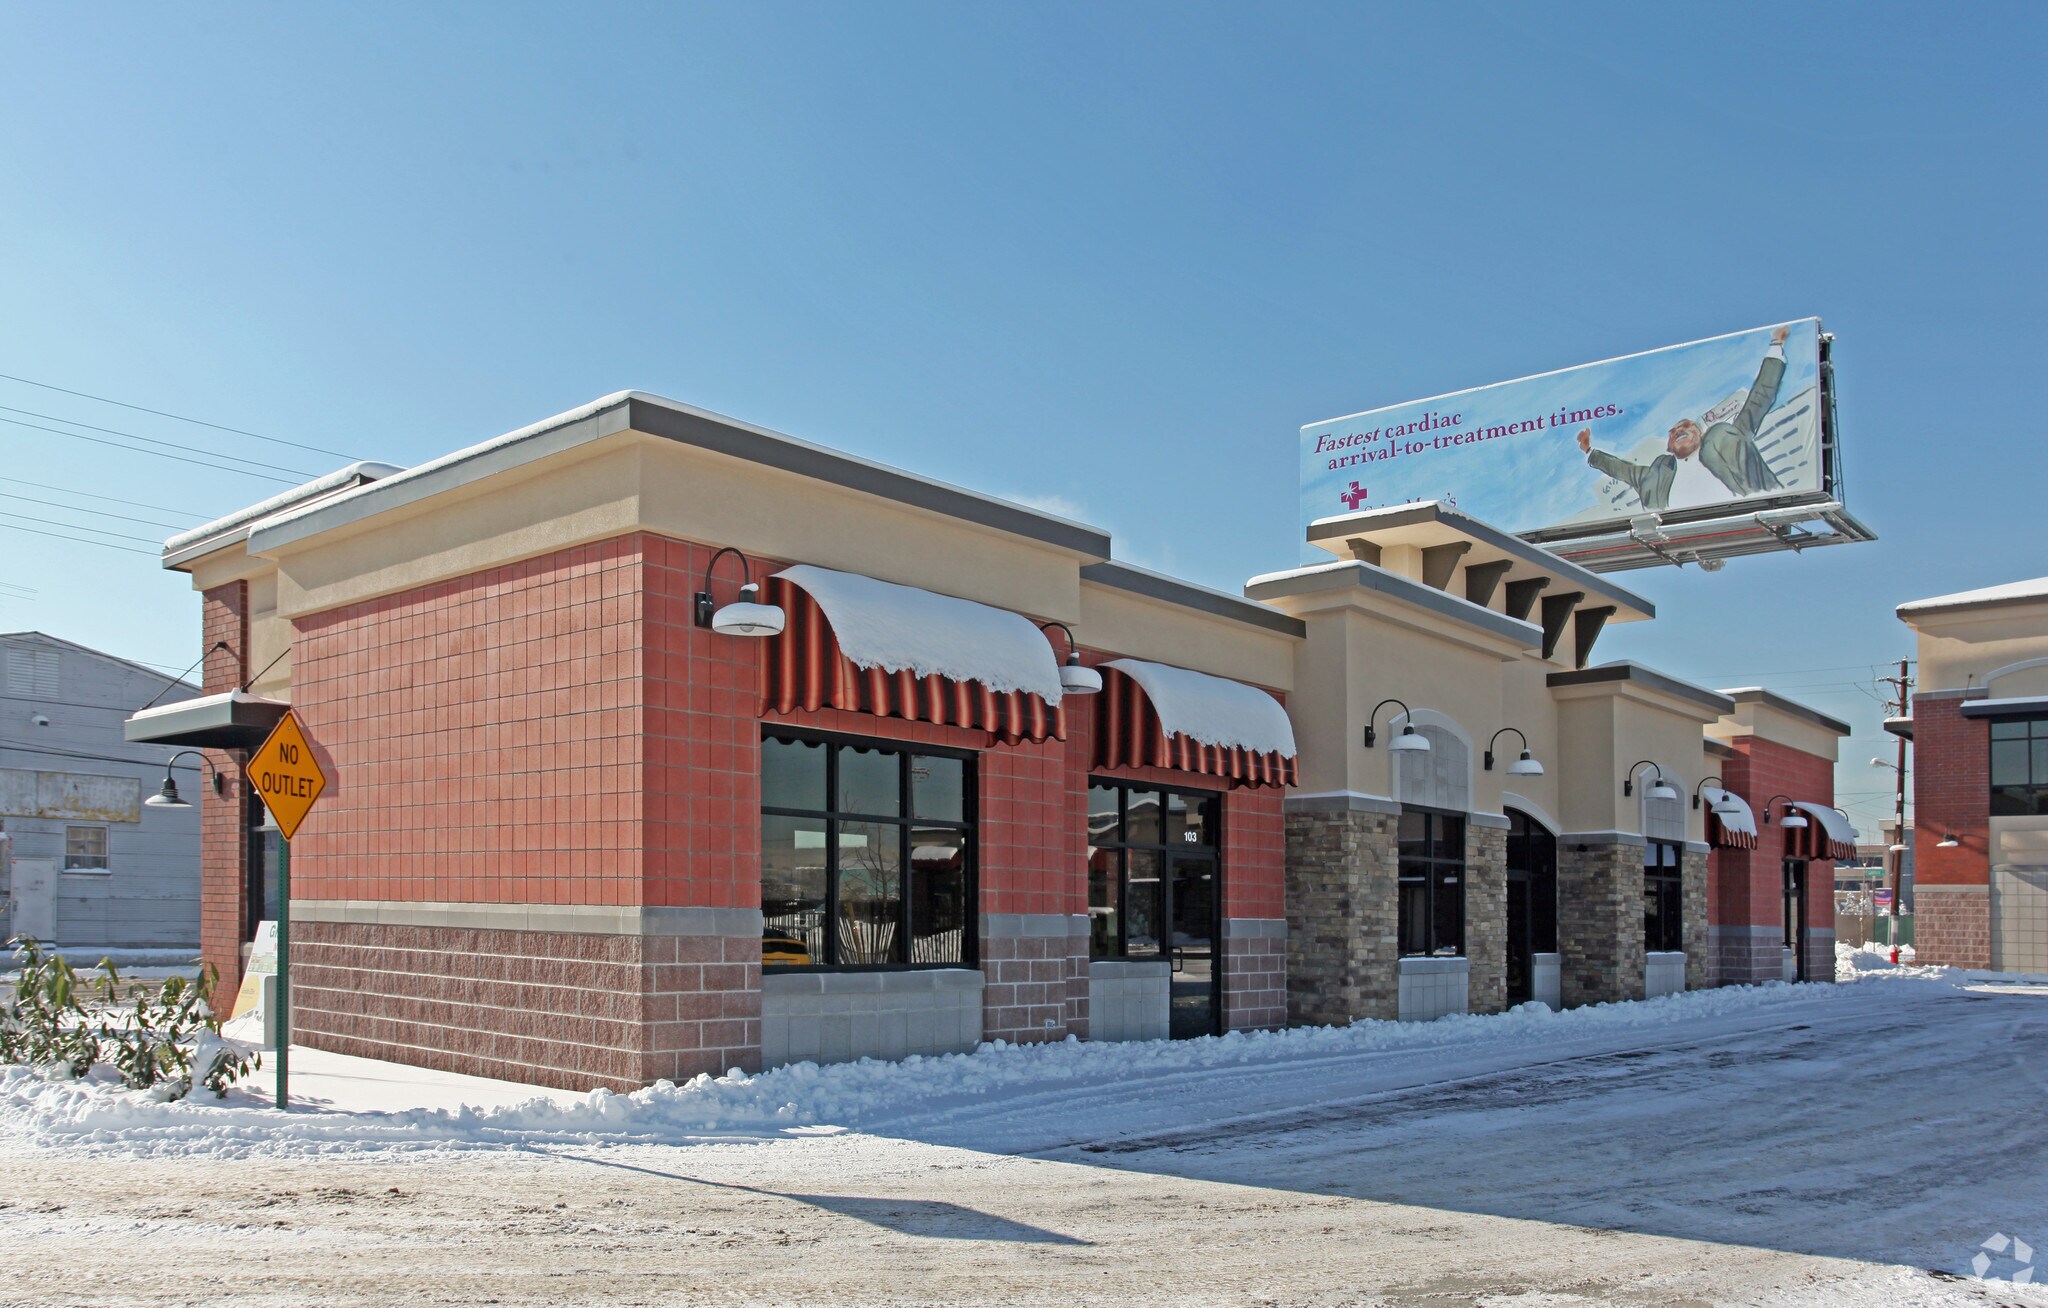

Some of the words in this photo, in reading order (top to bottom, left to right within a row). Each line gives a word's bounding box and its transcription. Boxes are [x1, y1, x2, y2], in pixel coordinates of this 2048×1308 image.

[1314, 427, 1381, 454] Fastest
[1385, 412, 1462, 439] cardiac
[1328, 415, 1545, 471] arrival-to-treatment
[1549, 403, 1623, 427] times.
[280, 742, 299, 765] NO
[262, 771, 314, 798] OUTLET
[1184, 831, 1197, 842] 103
